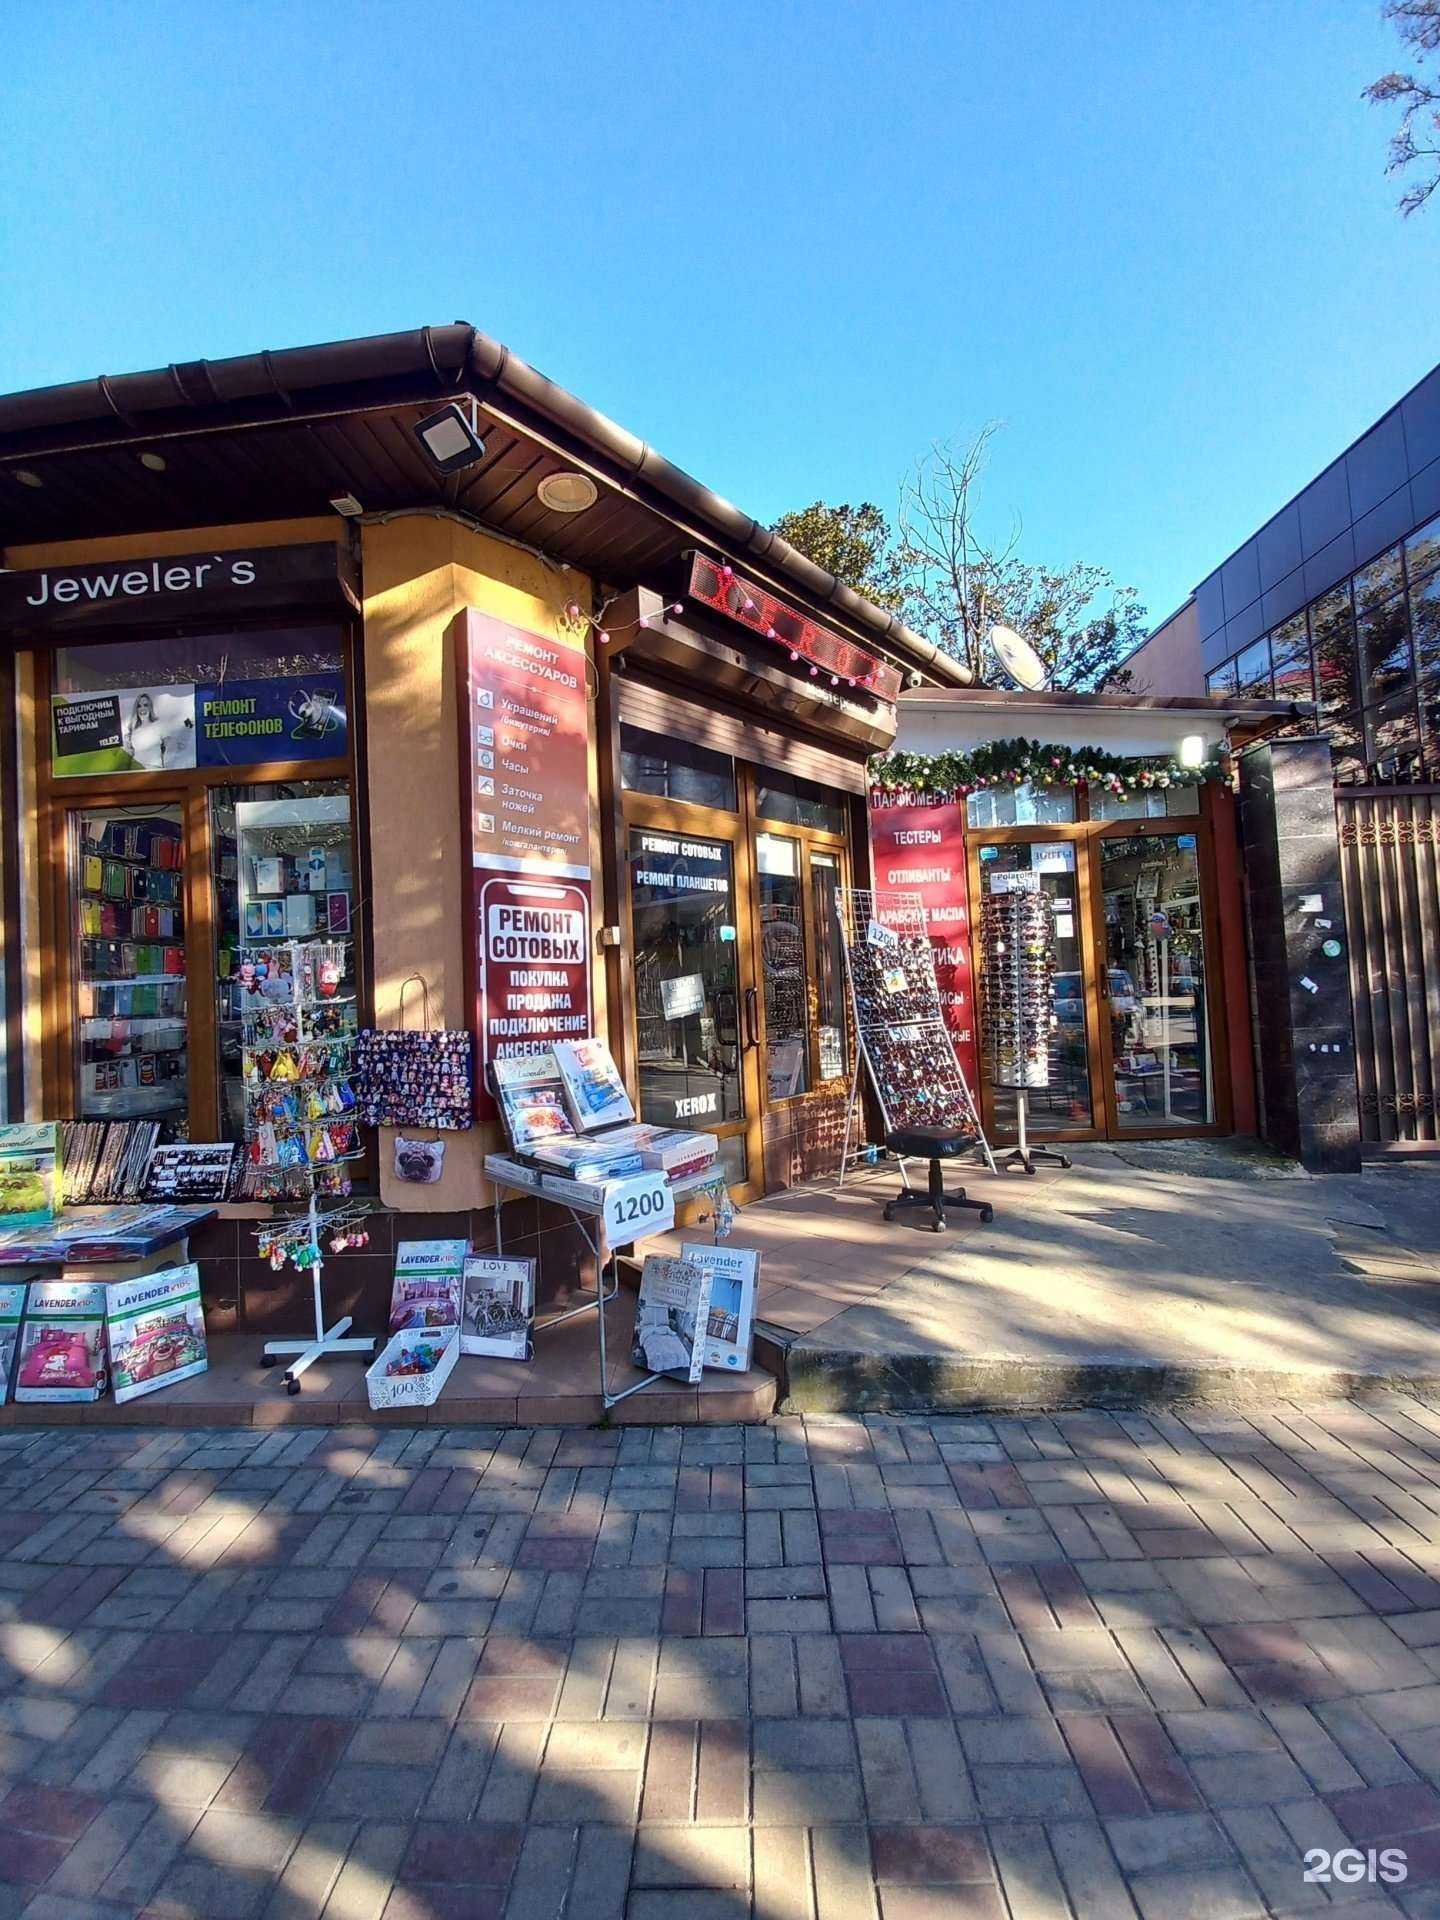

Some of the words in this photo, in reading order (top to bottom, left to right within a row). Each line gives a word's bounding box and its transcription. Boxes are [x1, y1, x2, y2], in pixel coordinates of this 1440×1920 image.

[505, 634, 560, 665] РЕМОНТ
[484, 647, 577, 689] АКСЕССУАРОВ
[57, 700, 113, 717] ПОДКЛЮЧИМ
[203, 698, 257, 718] РЕМОНТ
[501, 698, 558, 725] Украшений
[58, 718, 64, 726] К
[65, 710, 115, 725] ВЫГОДНЫМ
[59, 721, 99, 734] ТАРИФАМ
[204, 718, 283, 739] ТЕЛЕФОНОВ
[99, 735, 120, 747] TELE2
[502, 735, 527, 751] Очки
[501, 758, 529, 775] Часы
[501, 783, 543, 801] Заточка
[502, 800, 535, 814] ножей
[502, 820, 542, 838] Мелкий
[544, 829, 580, 844] ремонт
[893, 829, 941, 844] ТЕСТЕРЫ
[642, 836, 679, 855] РЕМОНТ
[681, 840, 722, 861] СОТОВЫХ
[636, 870, 674, 886] РЕМОНТ
[676, 873, 728, 892] ПЛАНШЕТОВ
[499, 909, 573, 935] РЕМОНТ
[931, 906, 966, 921] МАСЛА
[872, 928, 895, 947] 1200
[492, 935, 580, 960] СОТОВЫХ
[510, 970, 568, 987] ПОКУПКА
[507, 993, 572, 1013] ПРОДАЖА
[490, 1014, 587, 1038] ПОДКЛЮЧЕНИЕ
[674, 1092, 717, 1119] XEROX
[614, 1189, 664, 1225] 1200
[401, 1255, 440, 1264] LAVENDER
[483, 1262, 510, 1272] LOVE
[34, 1299, 76, 1308] LAVENDER
[118, 1285, 170, 1307] LAVENDER
